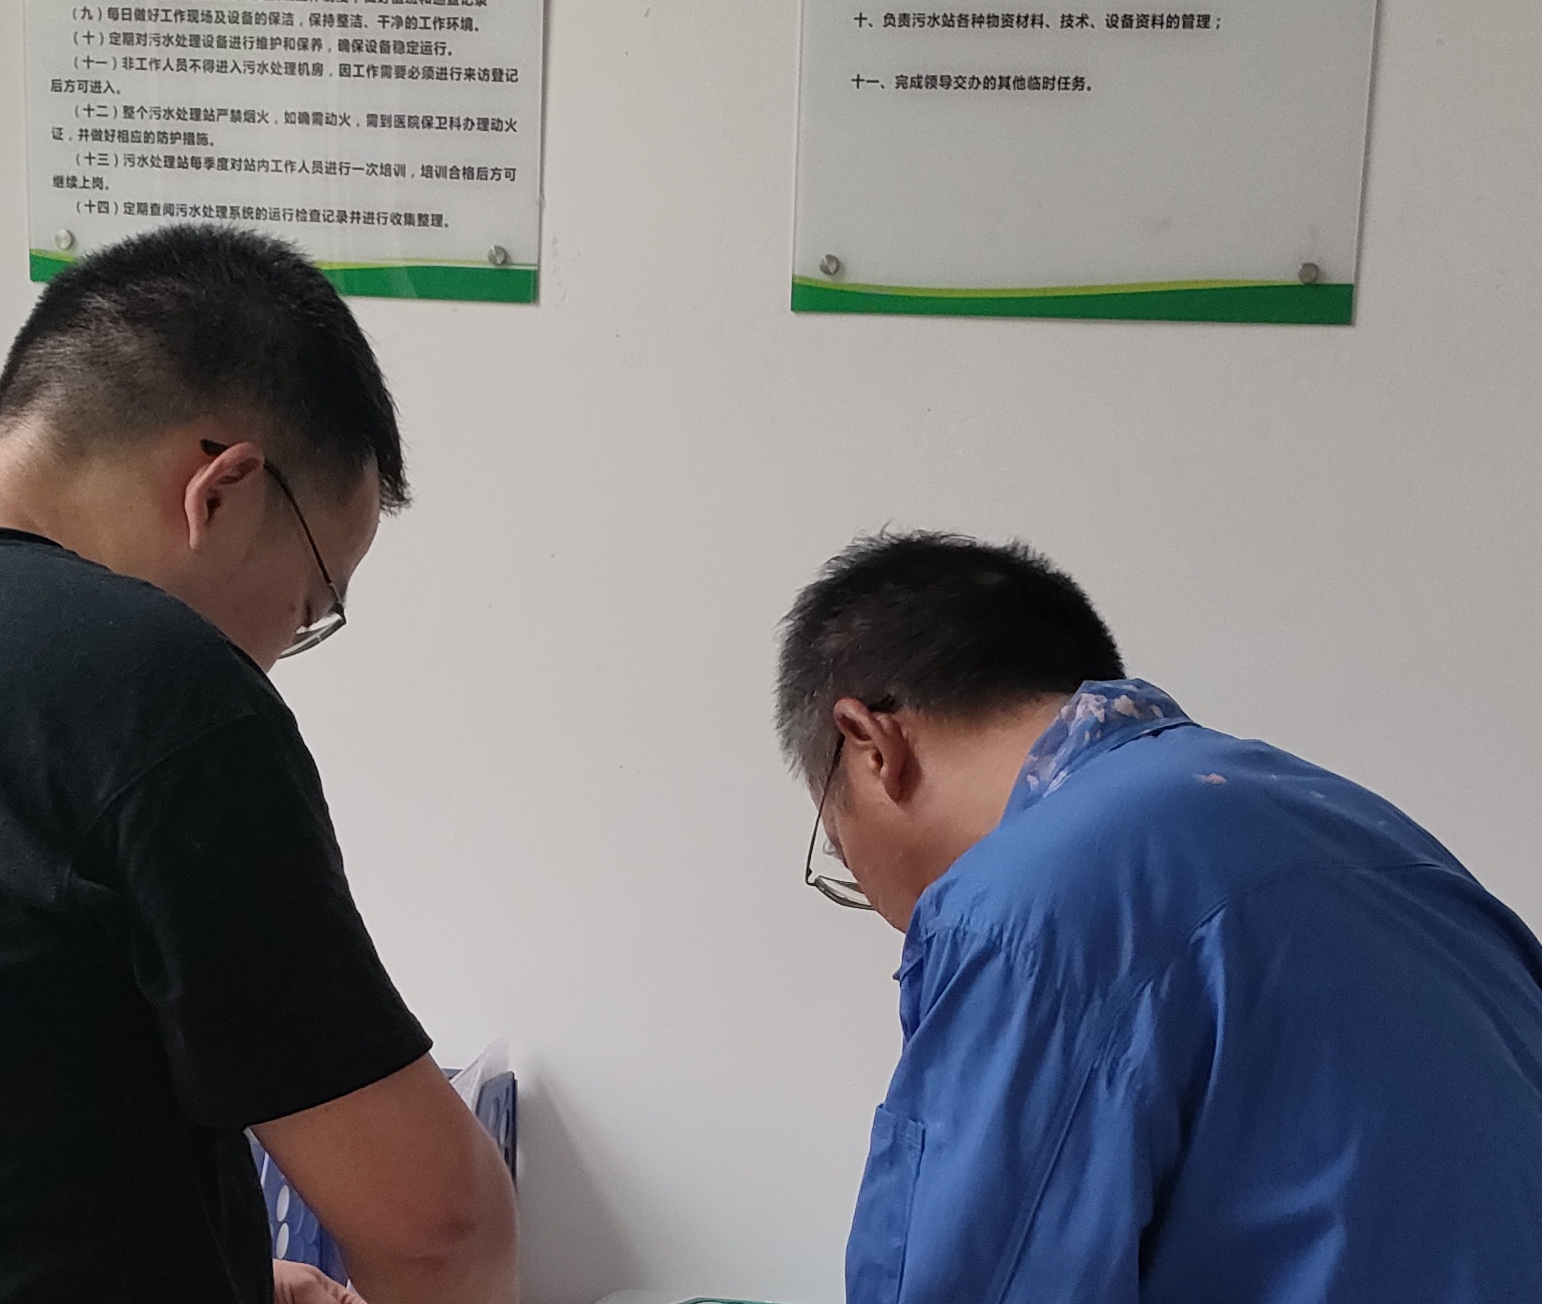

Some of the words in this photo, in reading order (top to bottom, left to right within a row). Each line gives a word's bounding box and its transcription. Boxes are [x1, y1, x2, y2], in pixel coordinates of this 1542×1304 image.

[50, 78, 122, 96] 后方可进入。
[850, 73, 1093, 92] 十一、完成领导交办的其他临时任务。
[52, 174, 110, 191] 继续上岗。
